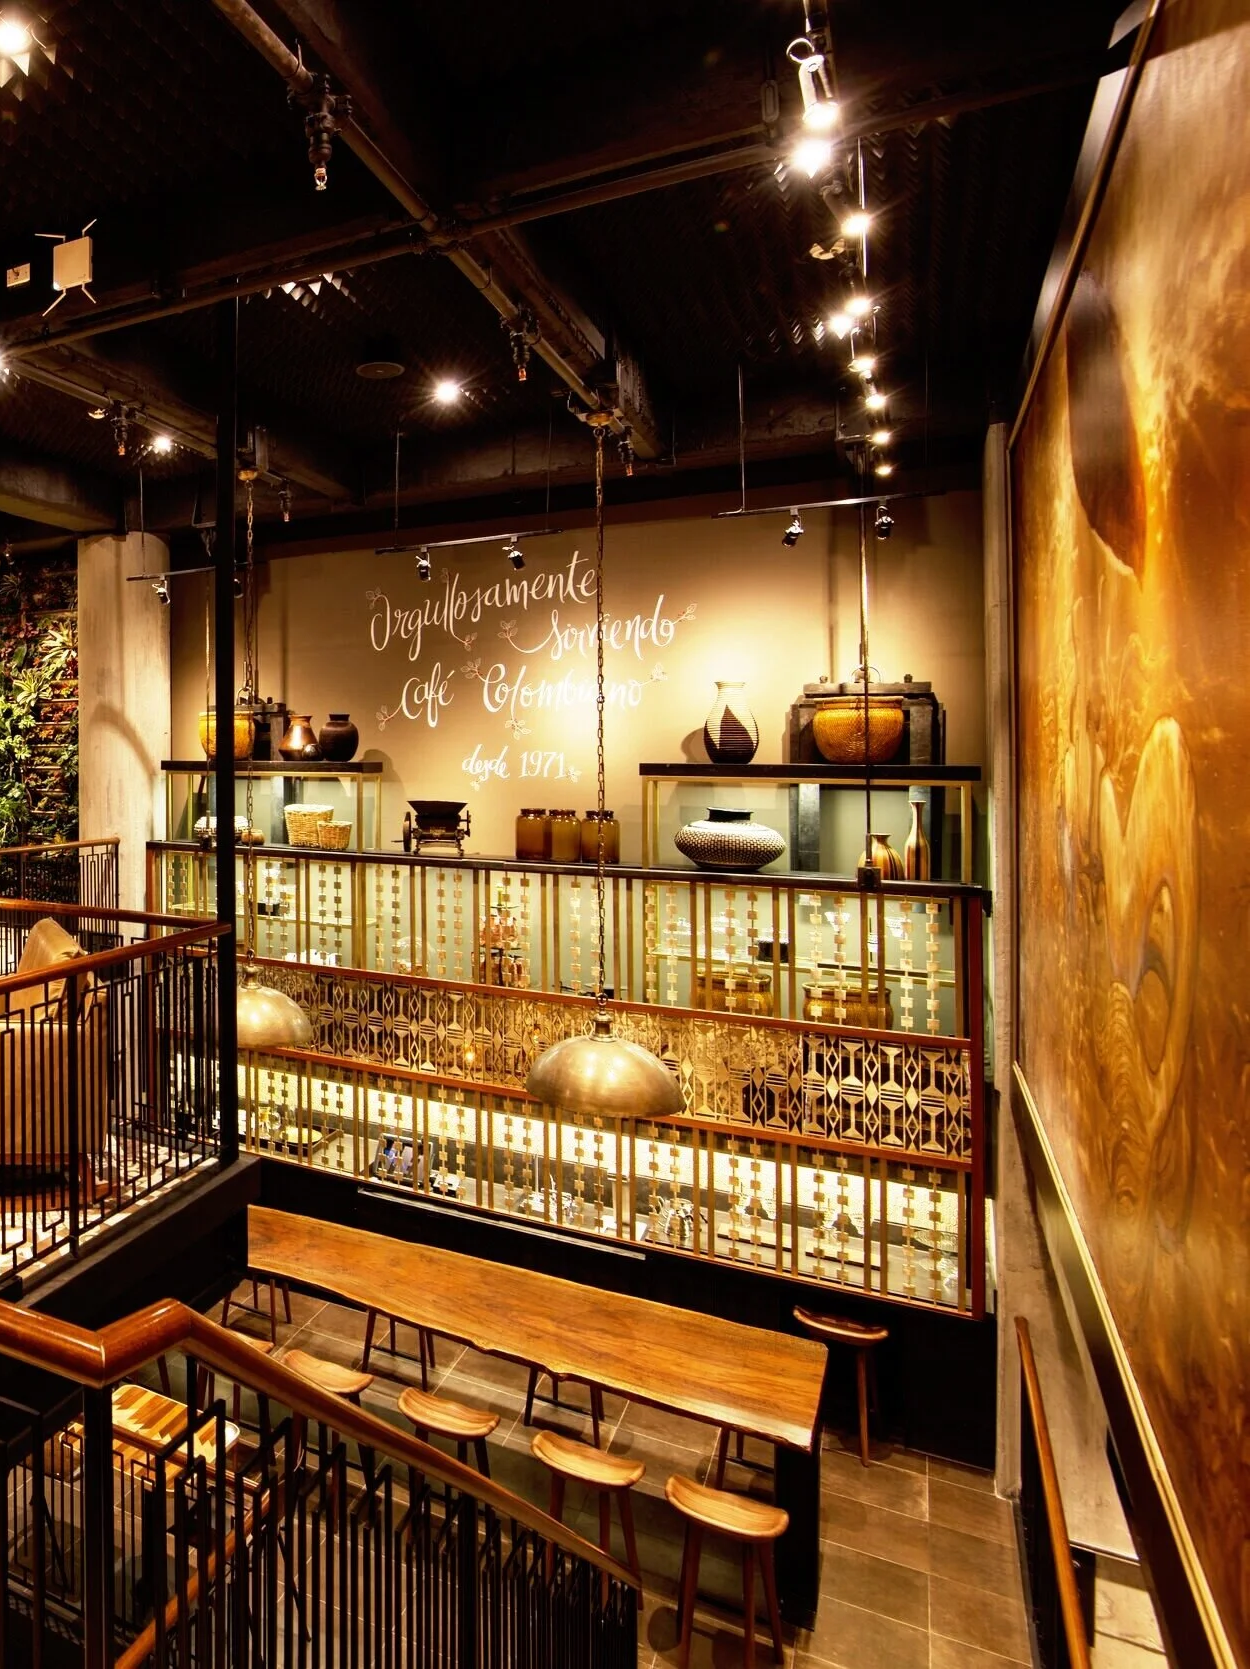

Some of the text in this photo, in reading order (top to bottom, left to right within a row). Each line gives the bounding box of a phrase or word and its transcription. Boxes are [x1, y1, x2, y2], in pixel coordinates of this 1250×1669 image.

[370, 550, 598, 661] Orgullosamente
[400, 661, 455, 728] Café
[461, 743, 568, 781] desde 1971
